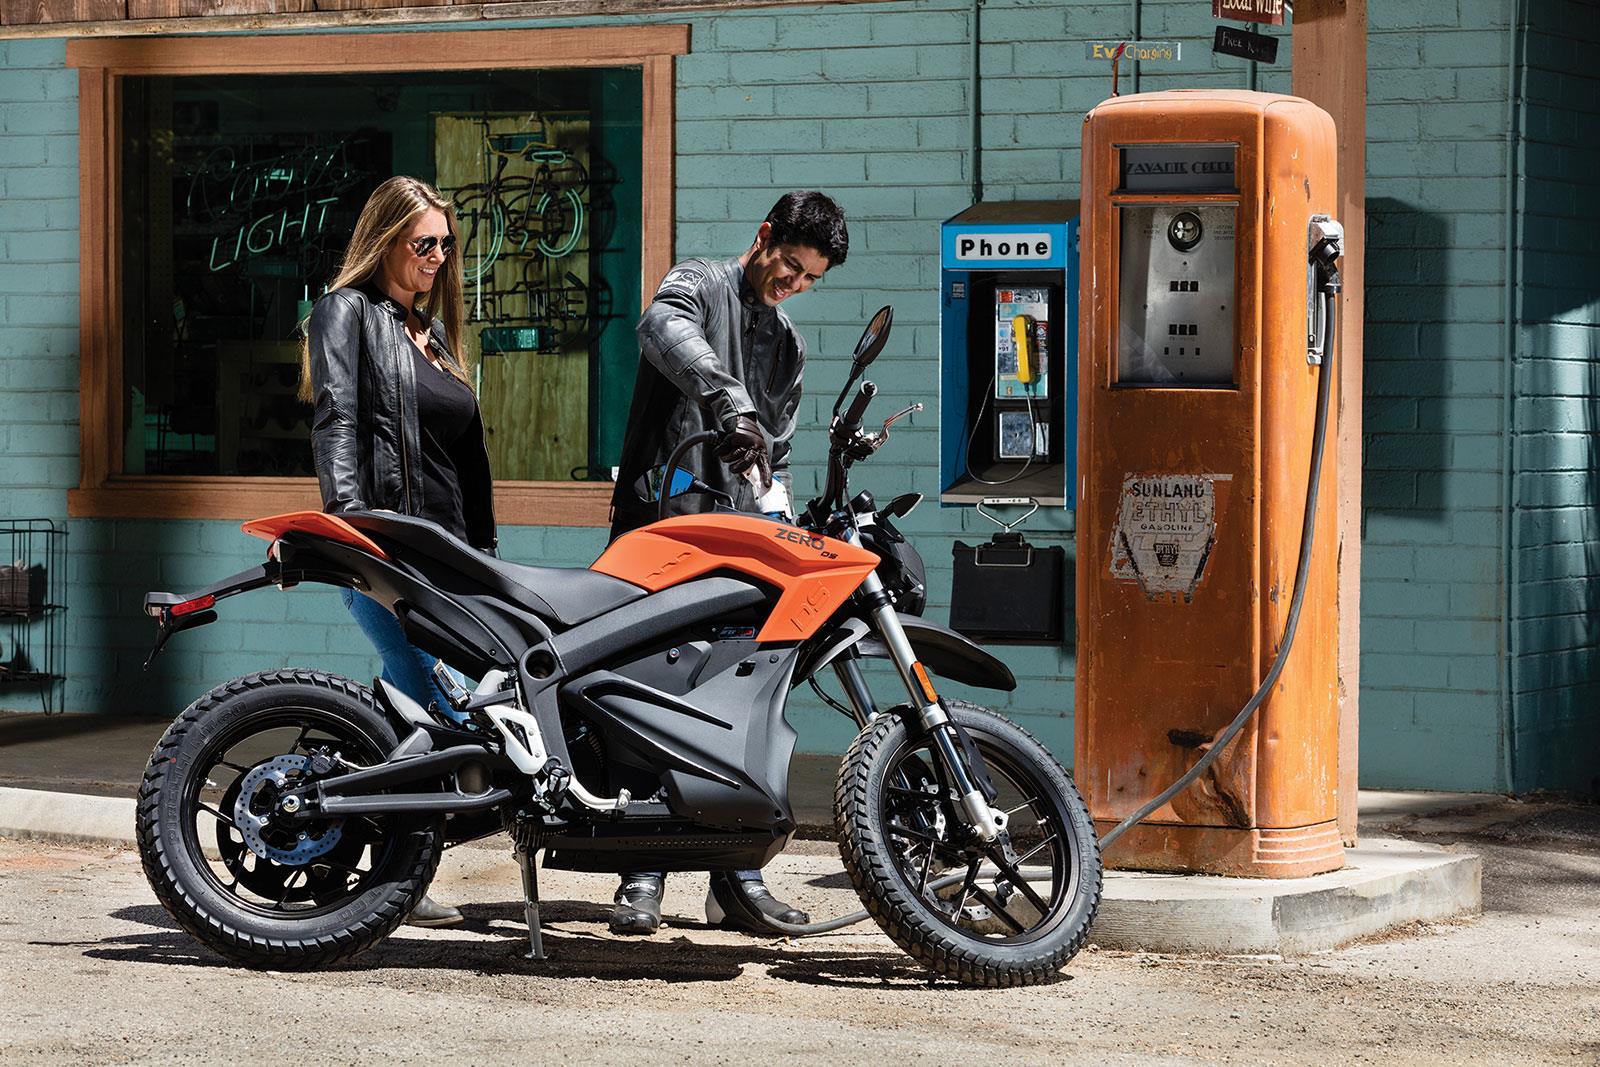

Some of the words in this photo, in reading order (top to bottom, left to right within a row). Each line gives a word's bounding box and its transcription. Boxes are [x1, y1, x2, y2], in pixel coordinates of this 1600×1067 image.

[1254, 0, 1282, 14] Wine
[1123, 44, 1173, 61] Charging
[209, 197, 340, 272] LIGHT
[961, 238, 1049, 256] Phone
[1132, 483, 1204, 498] SUNLAND
[774, 528, 825, 550] ZERO
